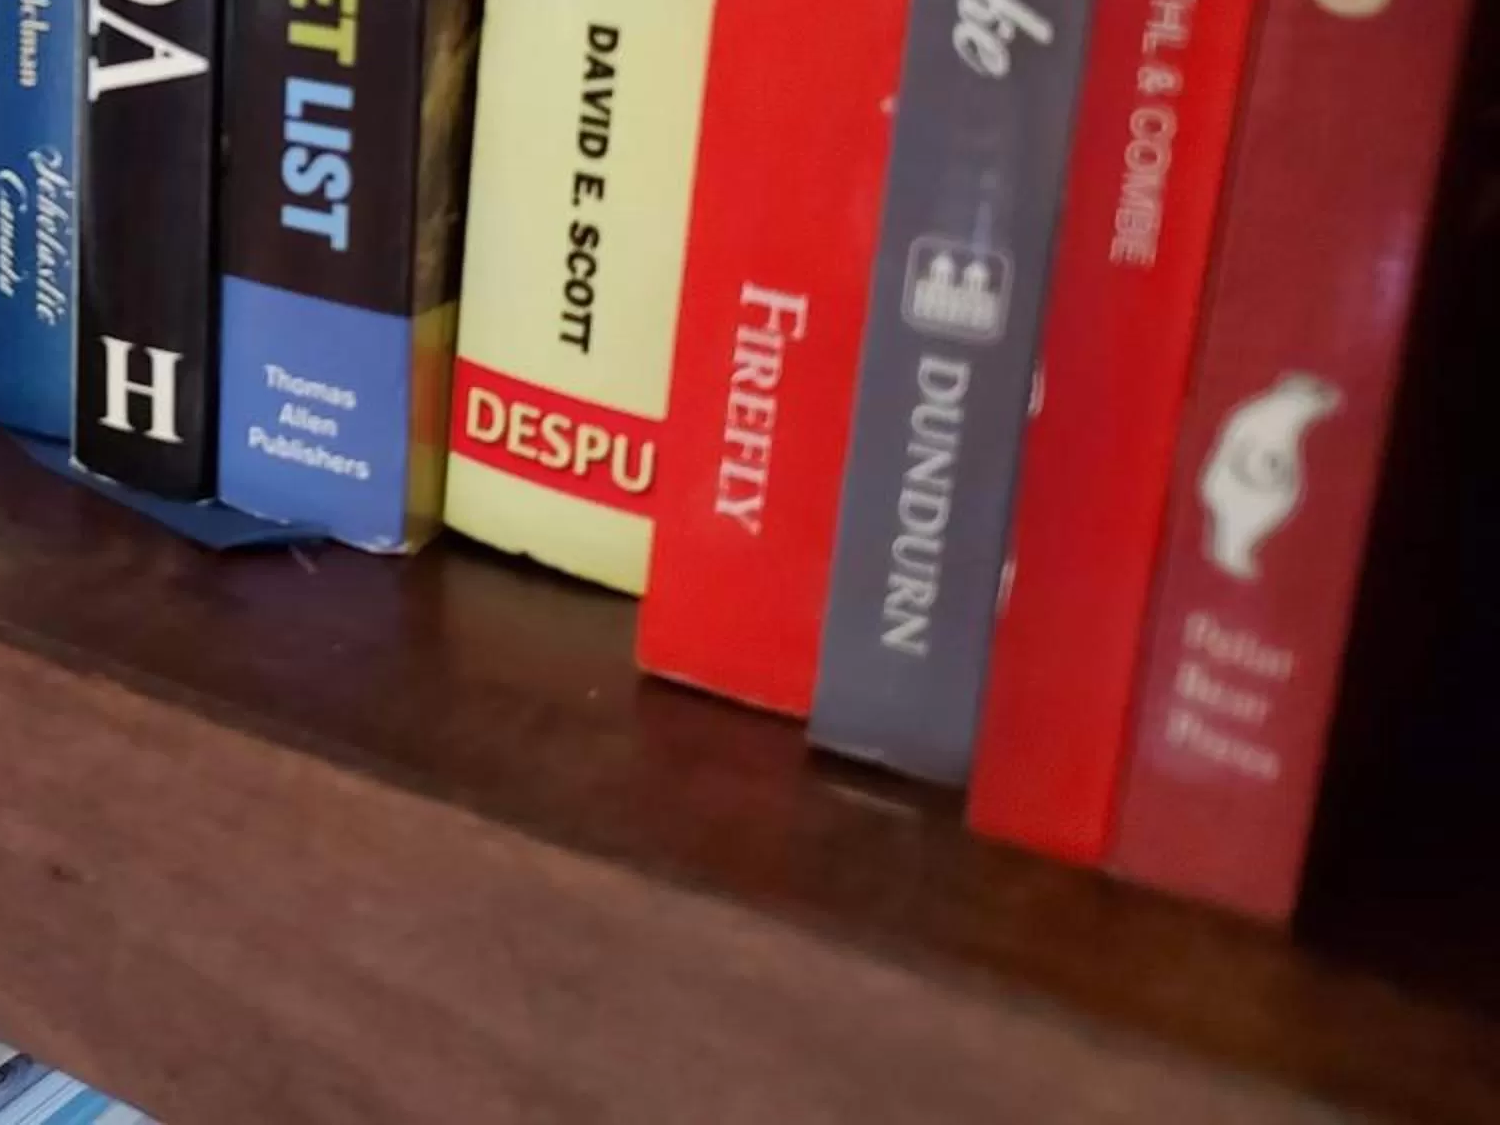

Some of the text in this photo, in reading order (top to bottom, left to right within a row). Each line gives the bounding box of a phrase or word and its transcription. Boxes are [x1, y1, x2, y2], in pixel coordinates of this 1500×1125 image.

[1137, 62, 1184, 98] &
[280, 76, 355, 251] LIST
[558, 22, 620, 355] DAVID E. SCOTT
[1109, 106, 1177, 269] COMBE
[0, 170, 29, 298] Canada
[28, 146, 76, 326] Scholastic
[98, 335, 184, 443] H
[264, 363, 357, 409] Thomas
[278, 400, 338, 438] Allen
[466, 386, 655, 494] DESPU
[714, 280, 810, 537] FIREFLY
[249, 426, 370, 480] Publishers
[879, 355, 972, 657] DUNDURN
